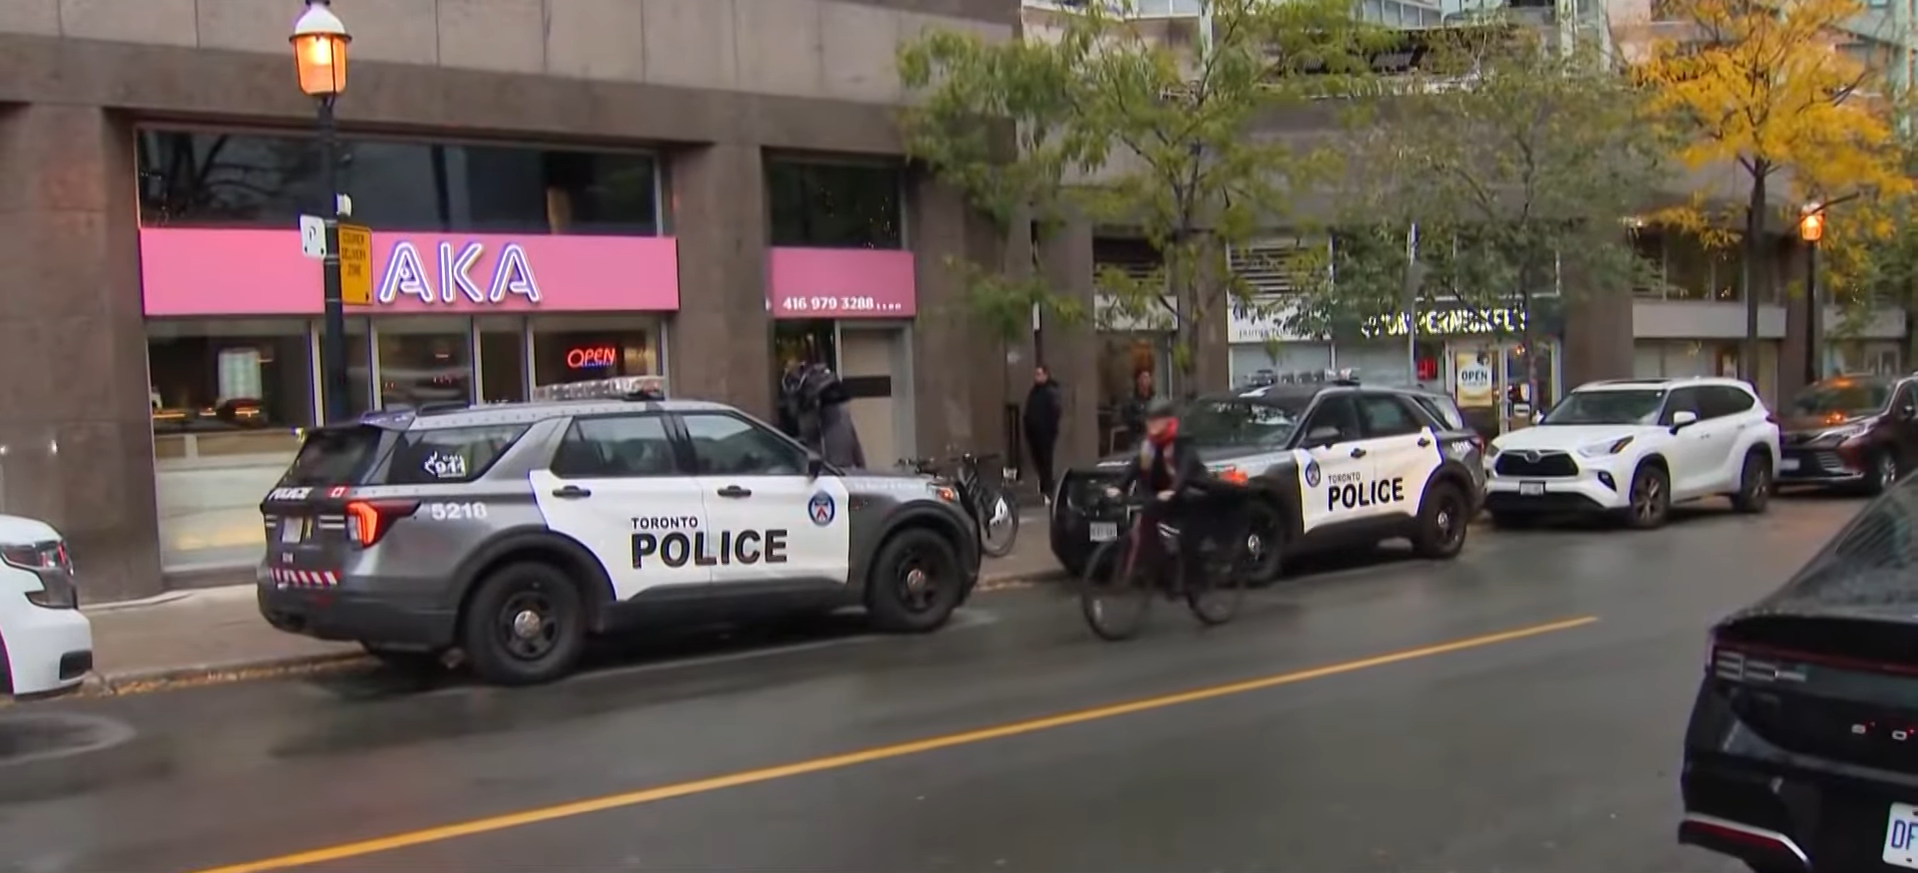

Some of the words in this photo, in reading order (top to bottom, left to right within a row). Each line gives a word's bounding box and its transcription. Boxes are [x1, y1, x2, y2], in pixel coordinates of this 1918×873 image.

[379, 241, 541, 303] AKA
[782, 296, 807, 310] 416
[811, 296, 837, 310] 979
[841, 296, 874, 310] 3288
[567, 347, 615, 368] OPEN
[1461, 369, 1488, 382] OPEN
[434, 458, 466, 475] 911
[1328, 473, 1361, 482] TORONTO
[267, 487, 314, 501] POLICE
[1327, 477, 1405, 511] POLICE
[631, 516, 698, 530] TORONTO
[631, 529, 788, 569] POLICE
